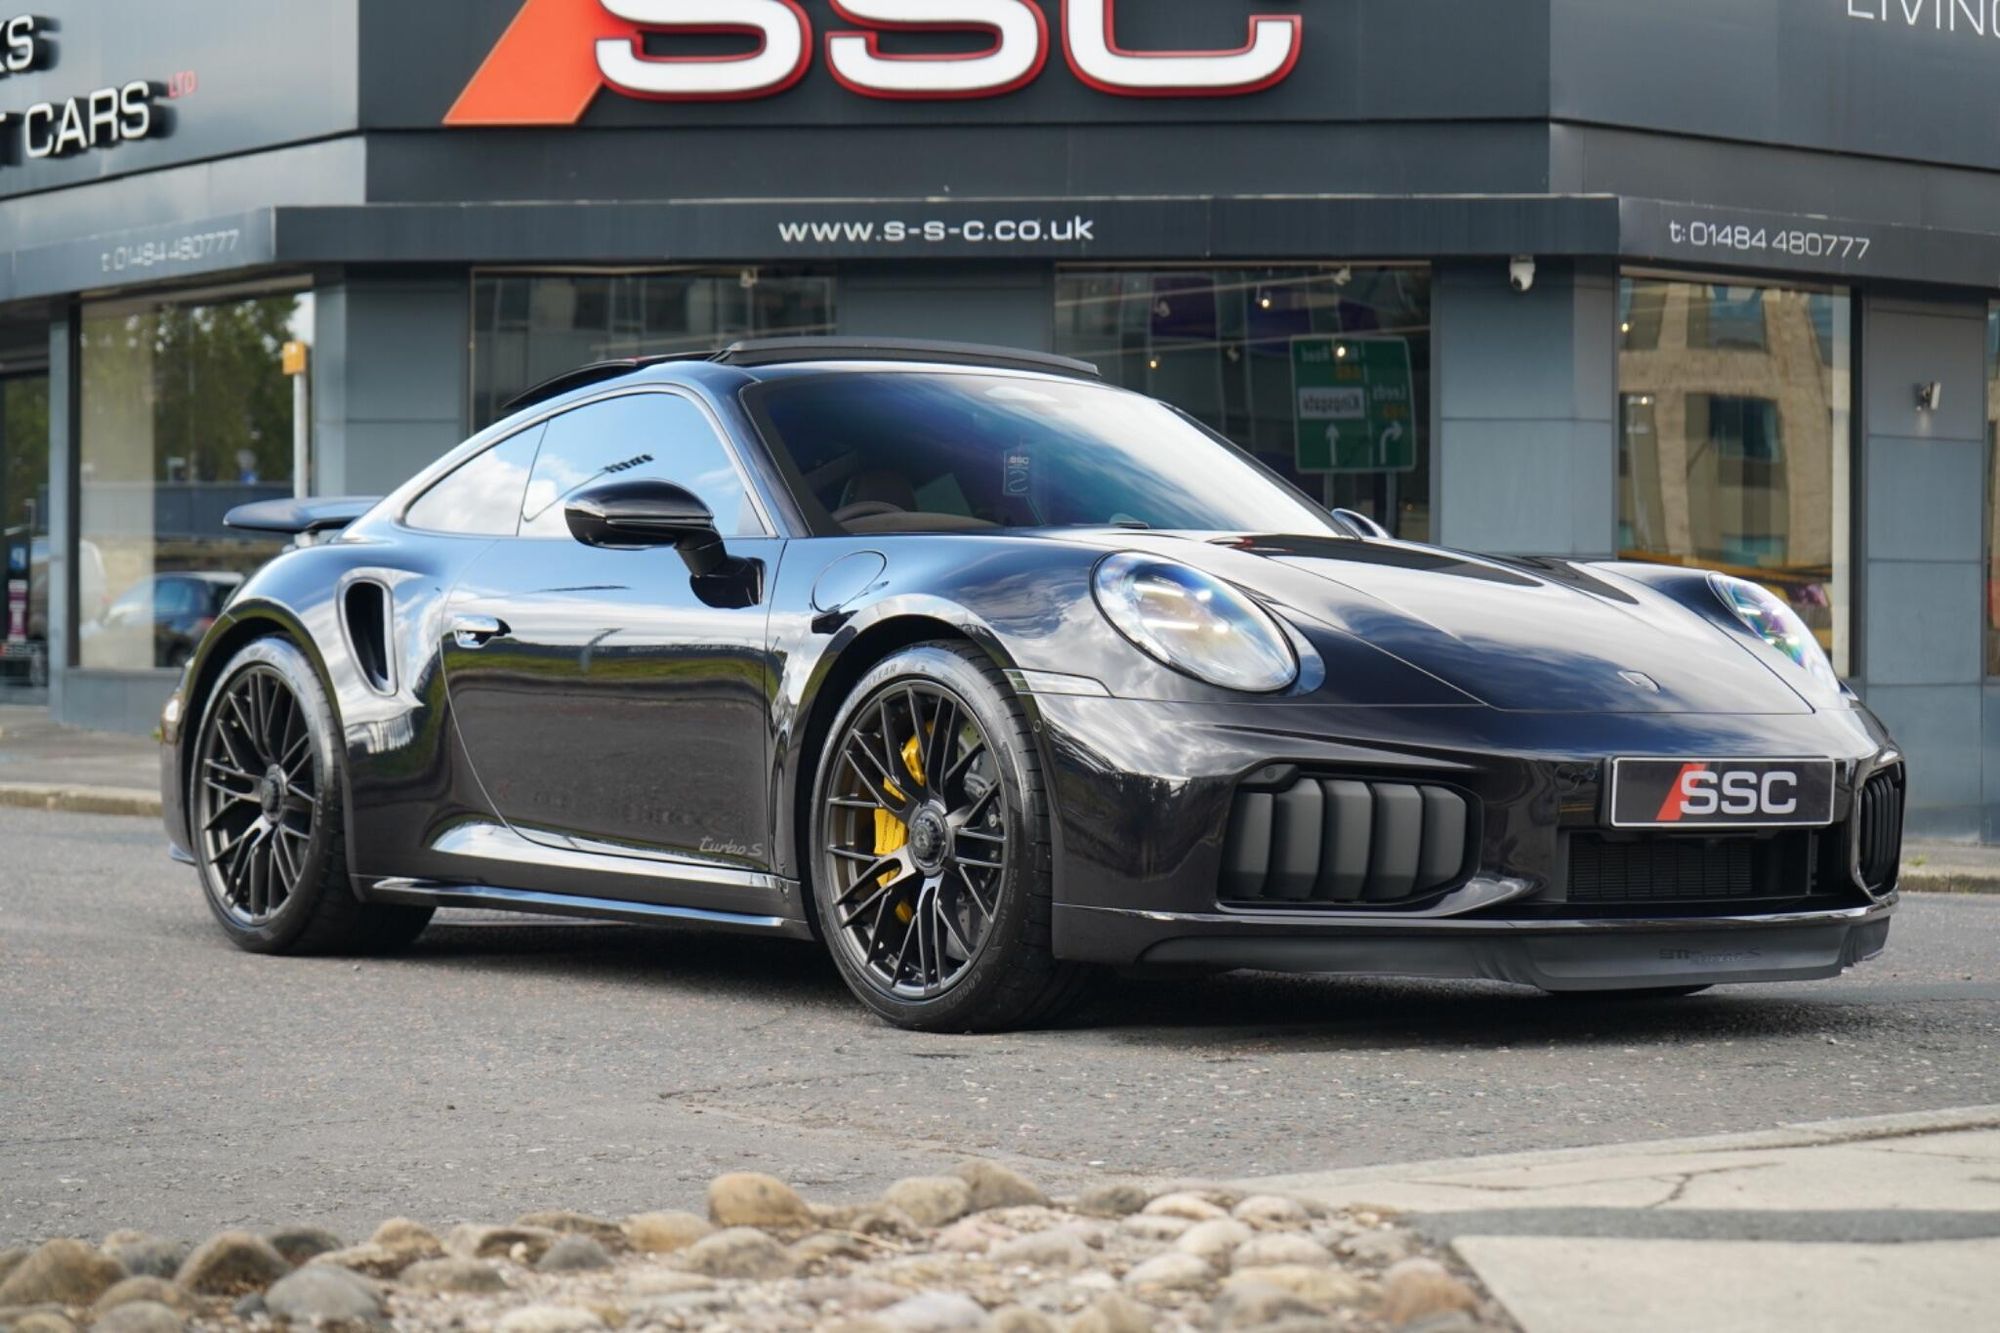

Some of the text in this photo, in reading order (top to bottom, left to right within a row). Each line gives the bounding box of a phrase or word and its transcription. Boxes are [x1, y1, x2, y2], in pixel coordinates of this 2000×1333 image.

[25, 70, 198, 158] CARS LTD
[778, 215, 1095, 242] www.s-s-c.co.uk
[1771, 230, 1871, 260] 480777
[1680, 770, 1797, 815] SSC
[700, 836, 763, 856] turbo S
